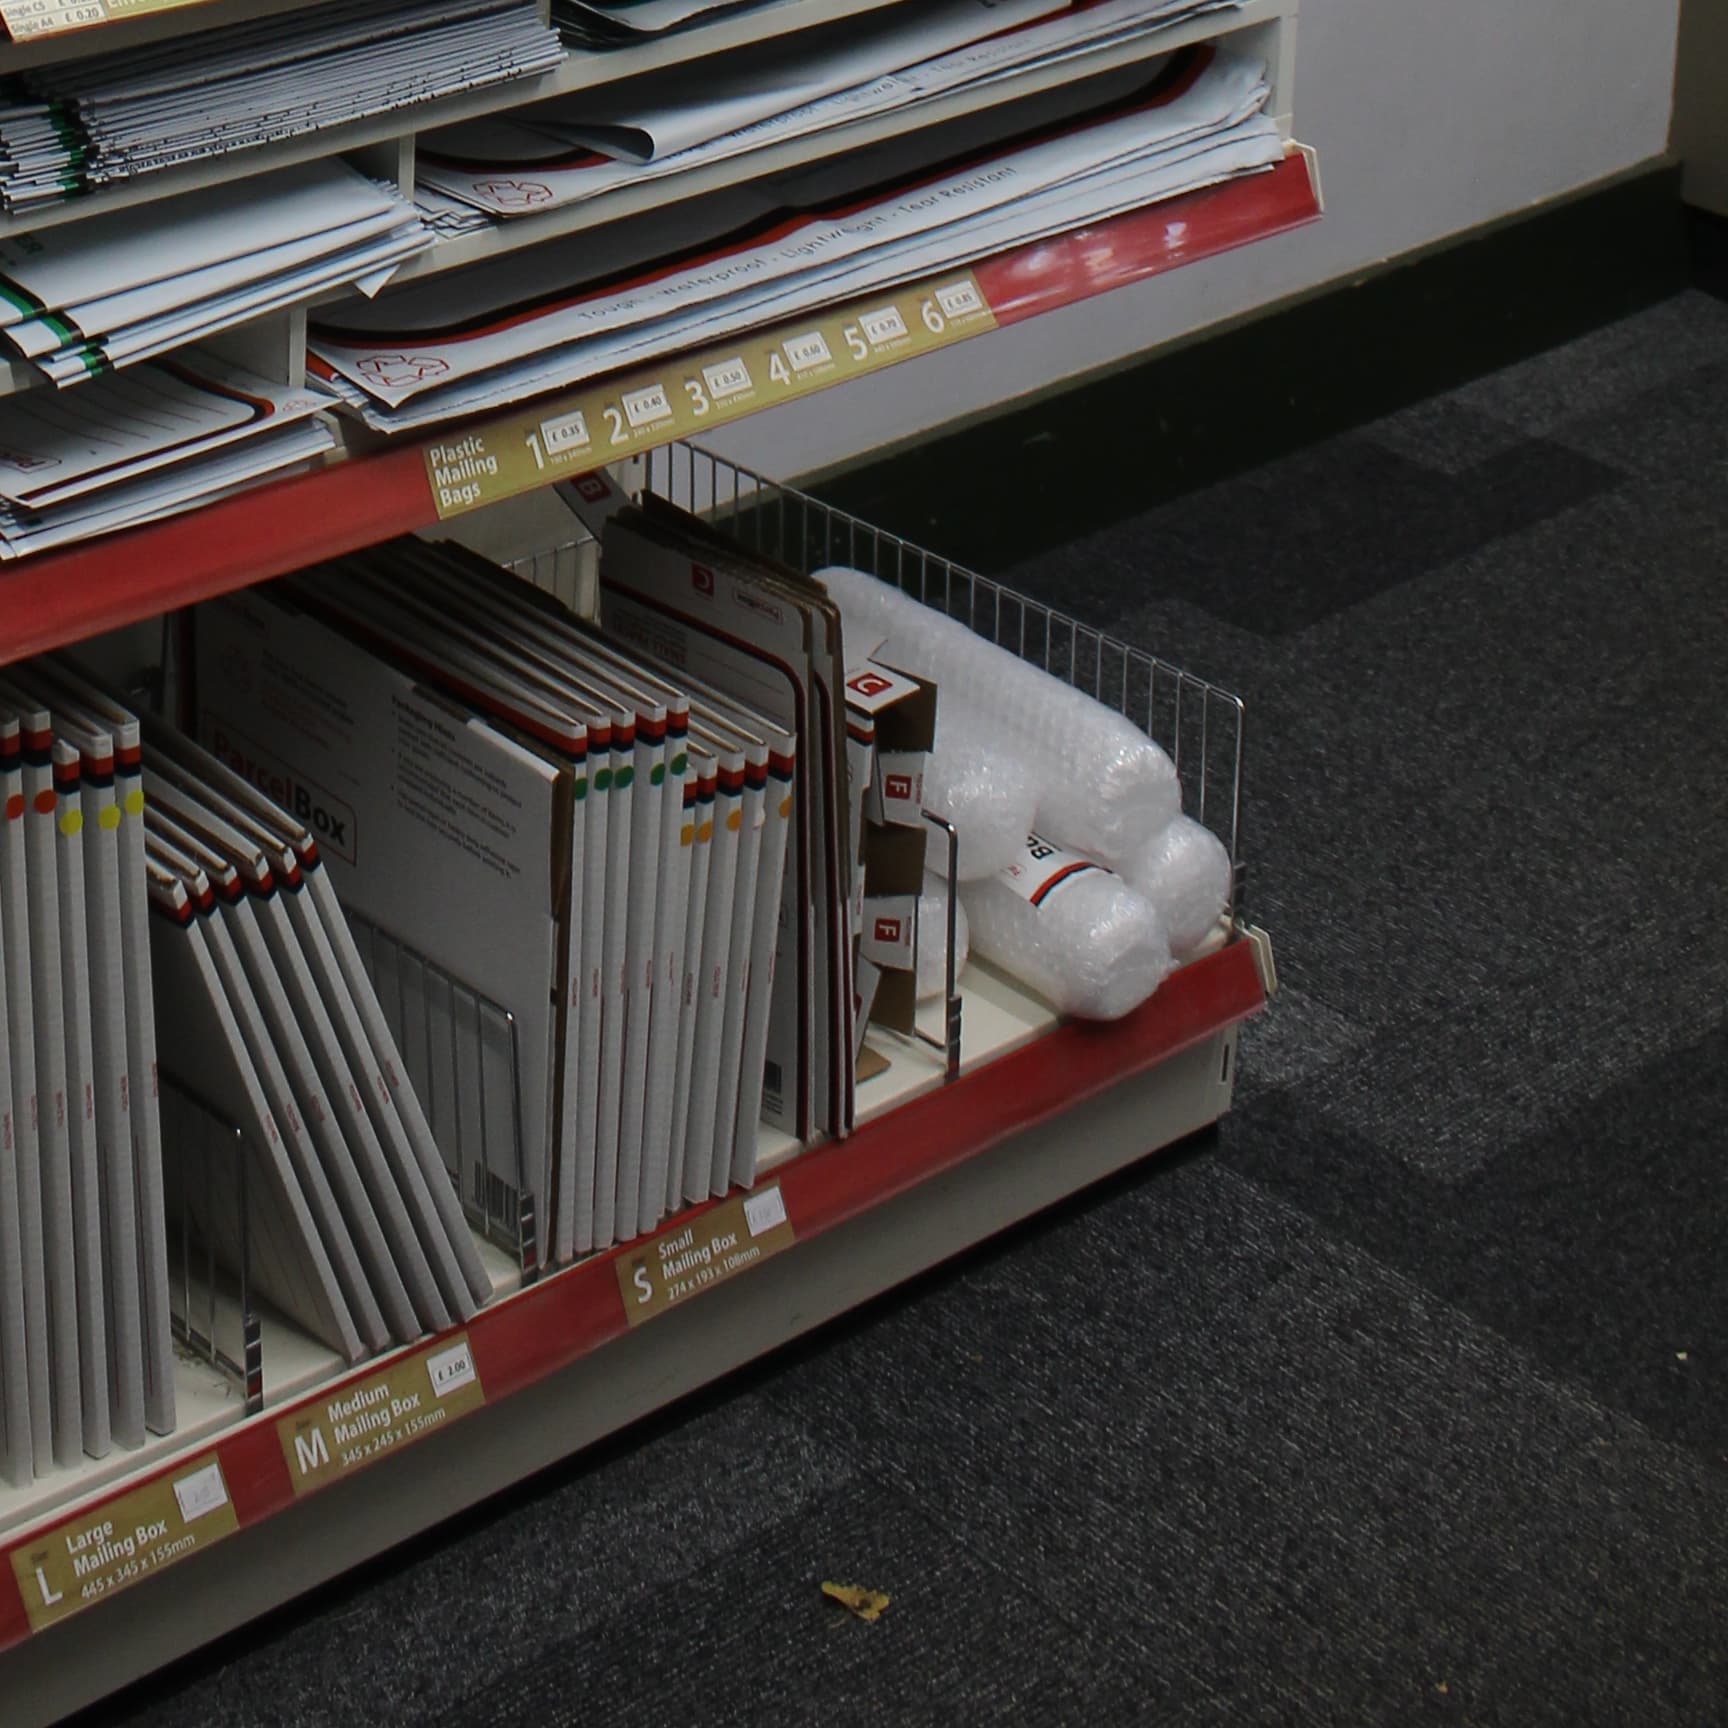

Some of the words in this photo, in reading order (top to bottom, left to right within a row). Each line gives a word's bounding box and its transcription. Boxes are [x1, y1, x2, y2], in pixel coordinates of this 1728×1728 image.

[429, 436, 486, 469] Plastic
[434, 451, 498, 489] Mailing
[439, 482, 482, 510] Bags
[658, 1228, 694, 1260] Small
[326, 1383, 390, 1424] Medium
[334, 1408, 392, 1445] Mailing
[392, 1392, 421, 1418] Box
[293, 1428, 330, 1475] M
[66, 1519, 114, 1554] Large
[73, 1533, 136, 1578] Mailing
[135, 1517, 168, 1545] Box
